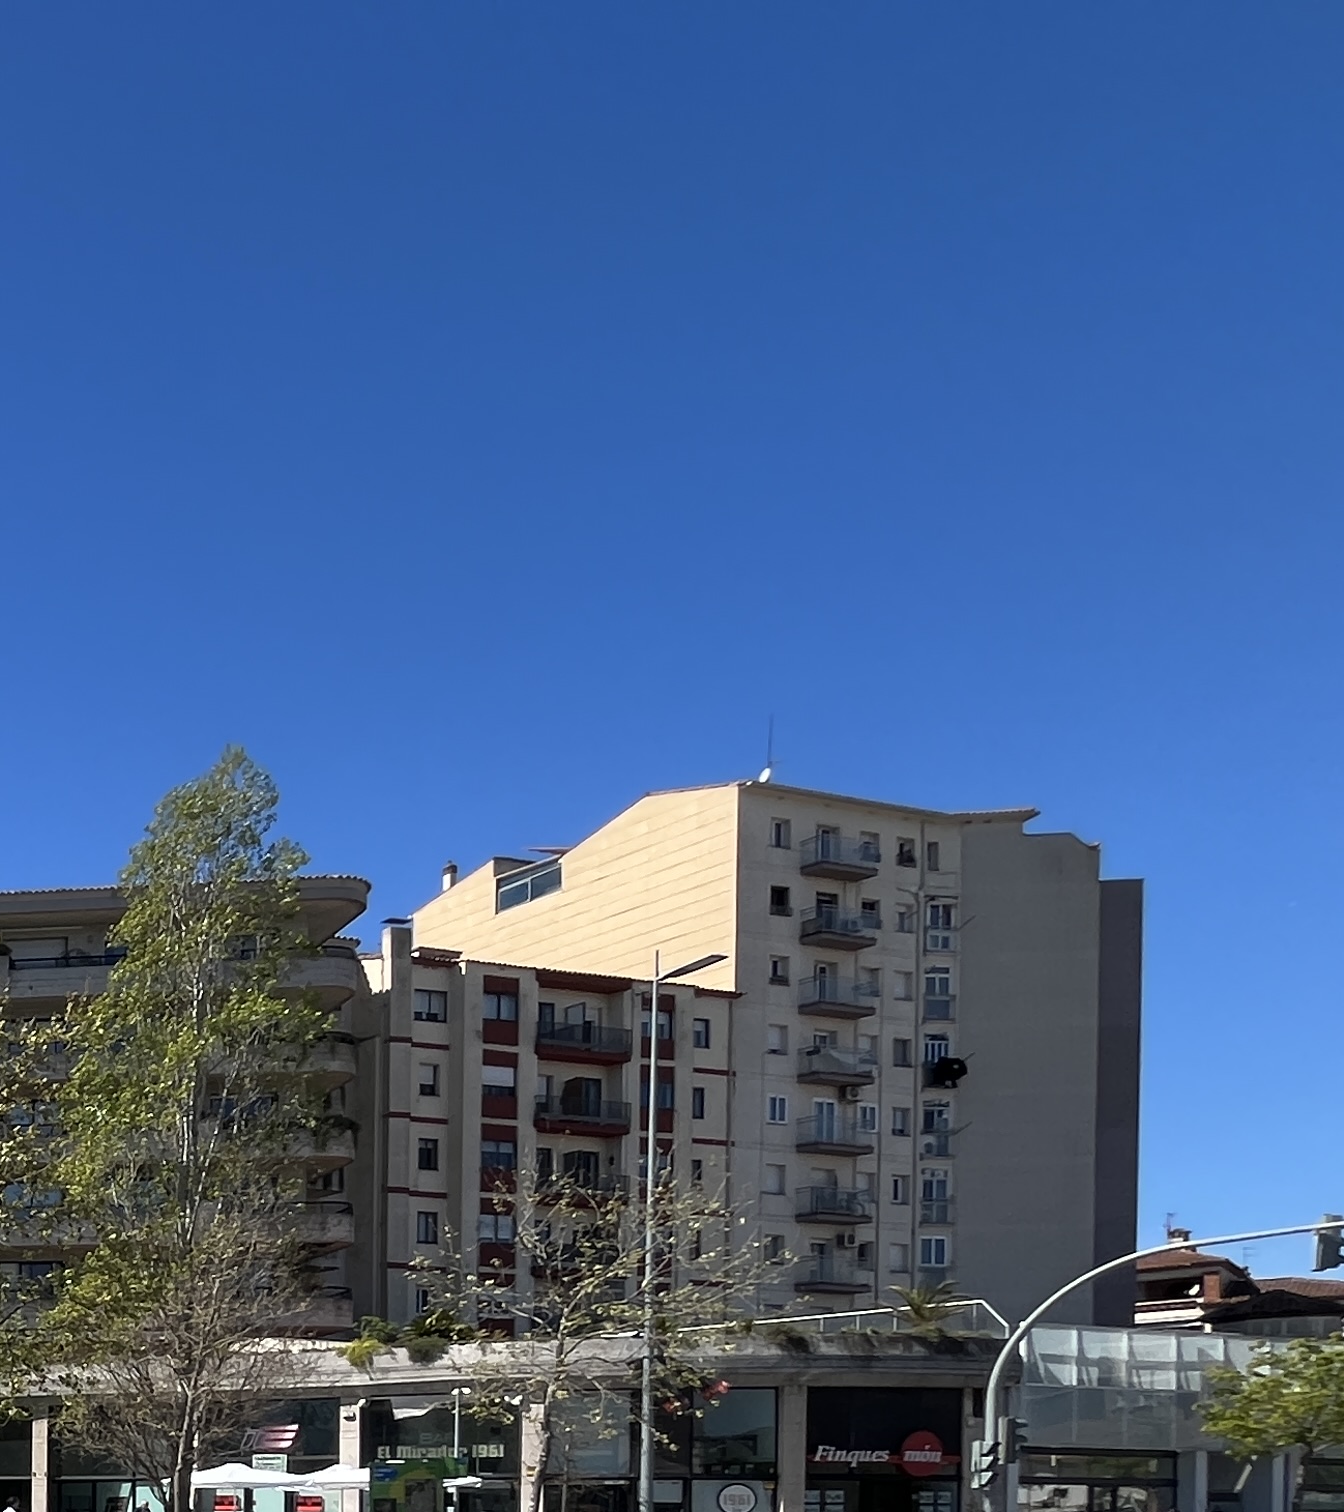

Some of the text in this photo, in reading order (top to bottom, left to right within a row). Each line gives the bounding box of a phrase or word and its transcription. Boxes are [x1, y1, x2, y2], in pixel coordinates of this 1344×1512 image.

[396, 1444, 468, 1459] Mirador
[472, 1443, 505, 1458] 1961
[814, 1445, 890, 1468] Finques
